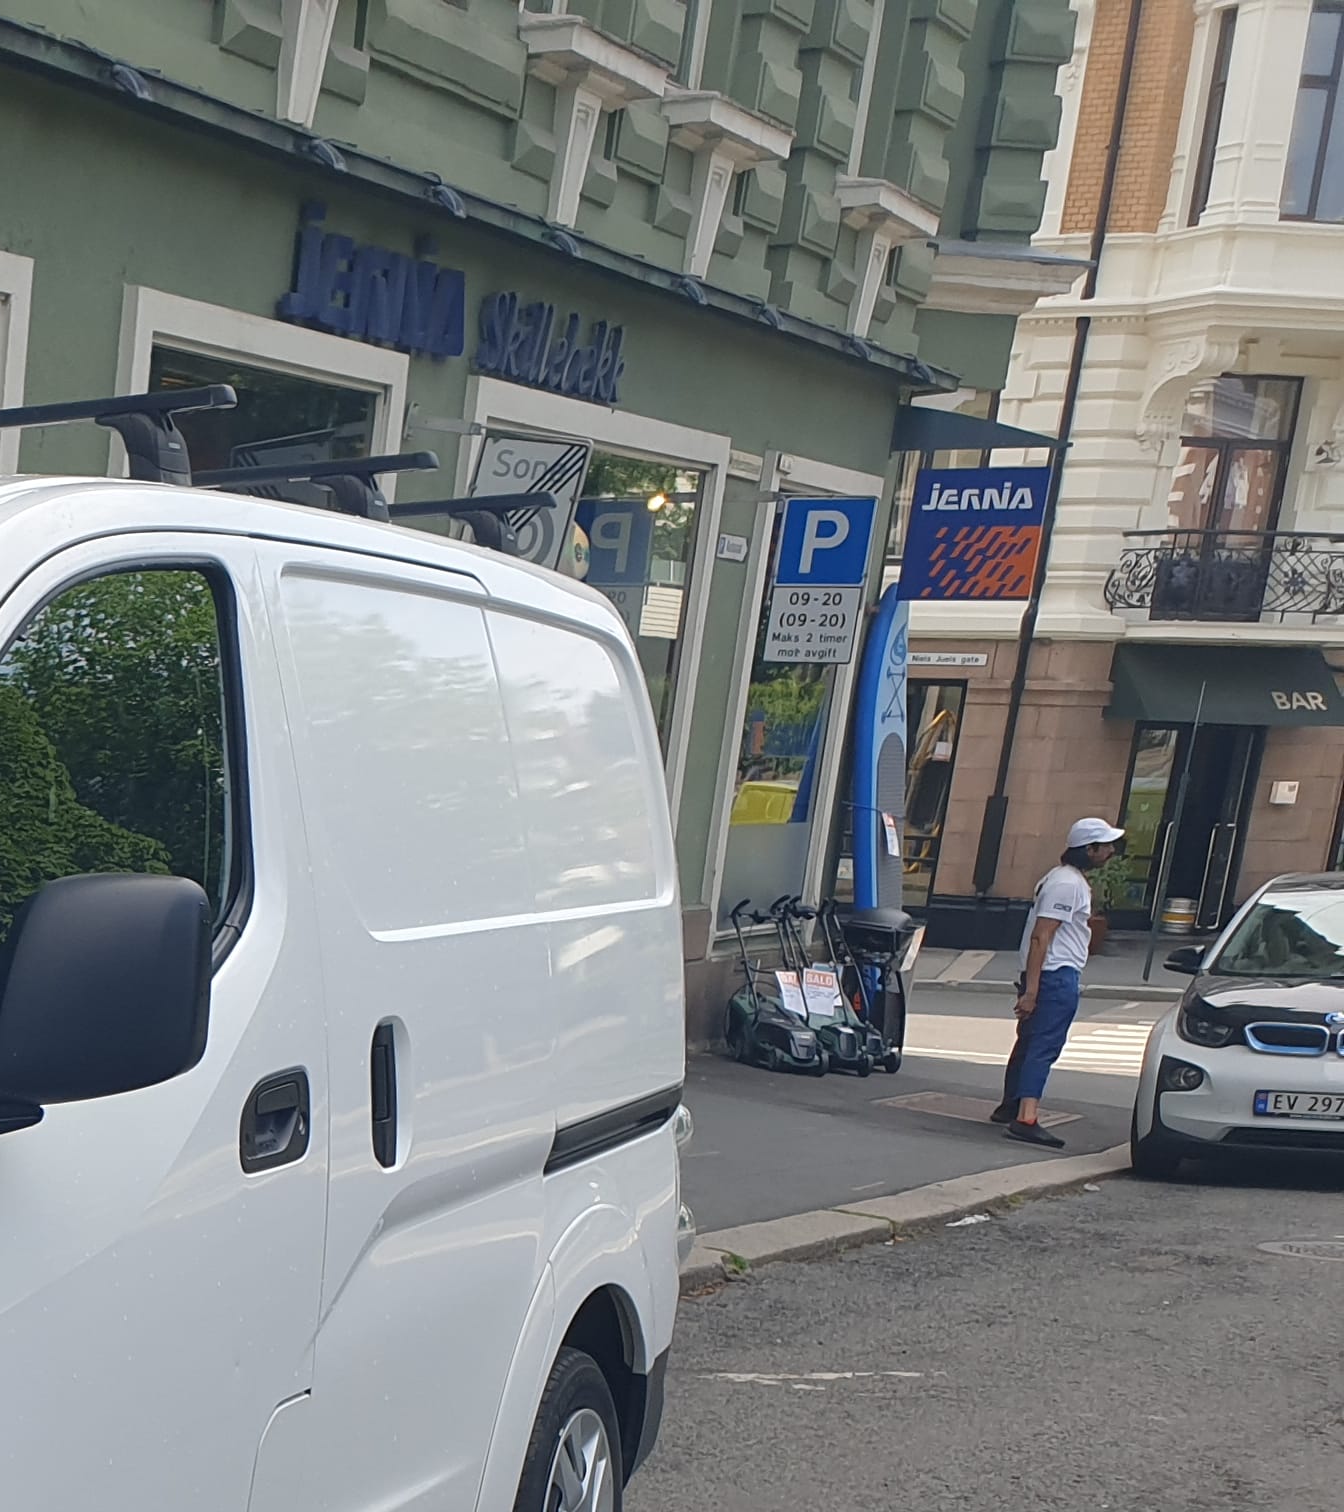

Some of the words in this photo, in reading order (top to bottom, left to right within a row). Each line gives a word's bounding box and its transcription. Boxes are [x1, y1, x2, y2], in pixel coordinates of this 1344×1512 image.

[798, 510, 850, 574] P
[789, 591, 842, 606] 09-20
[779, 612, 846, 629] (09-20)
[772, 632, 799, 643] Maks
[805, 632, 813, 643] 2
[819, 633, 848, 643] timer
[804, 647, 837, 659] avgift
[1271, 691, 1328, 711] BAR
[1273, 1095, 1298, 1110] EV
